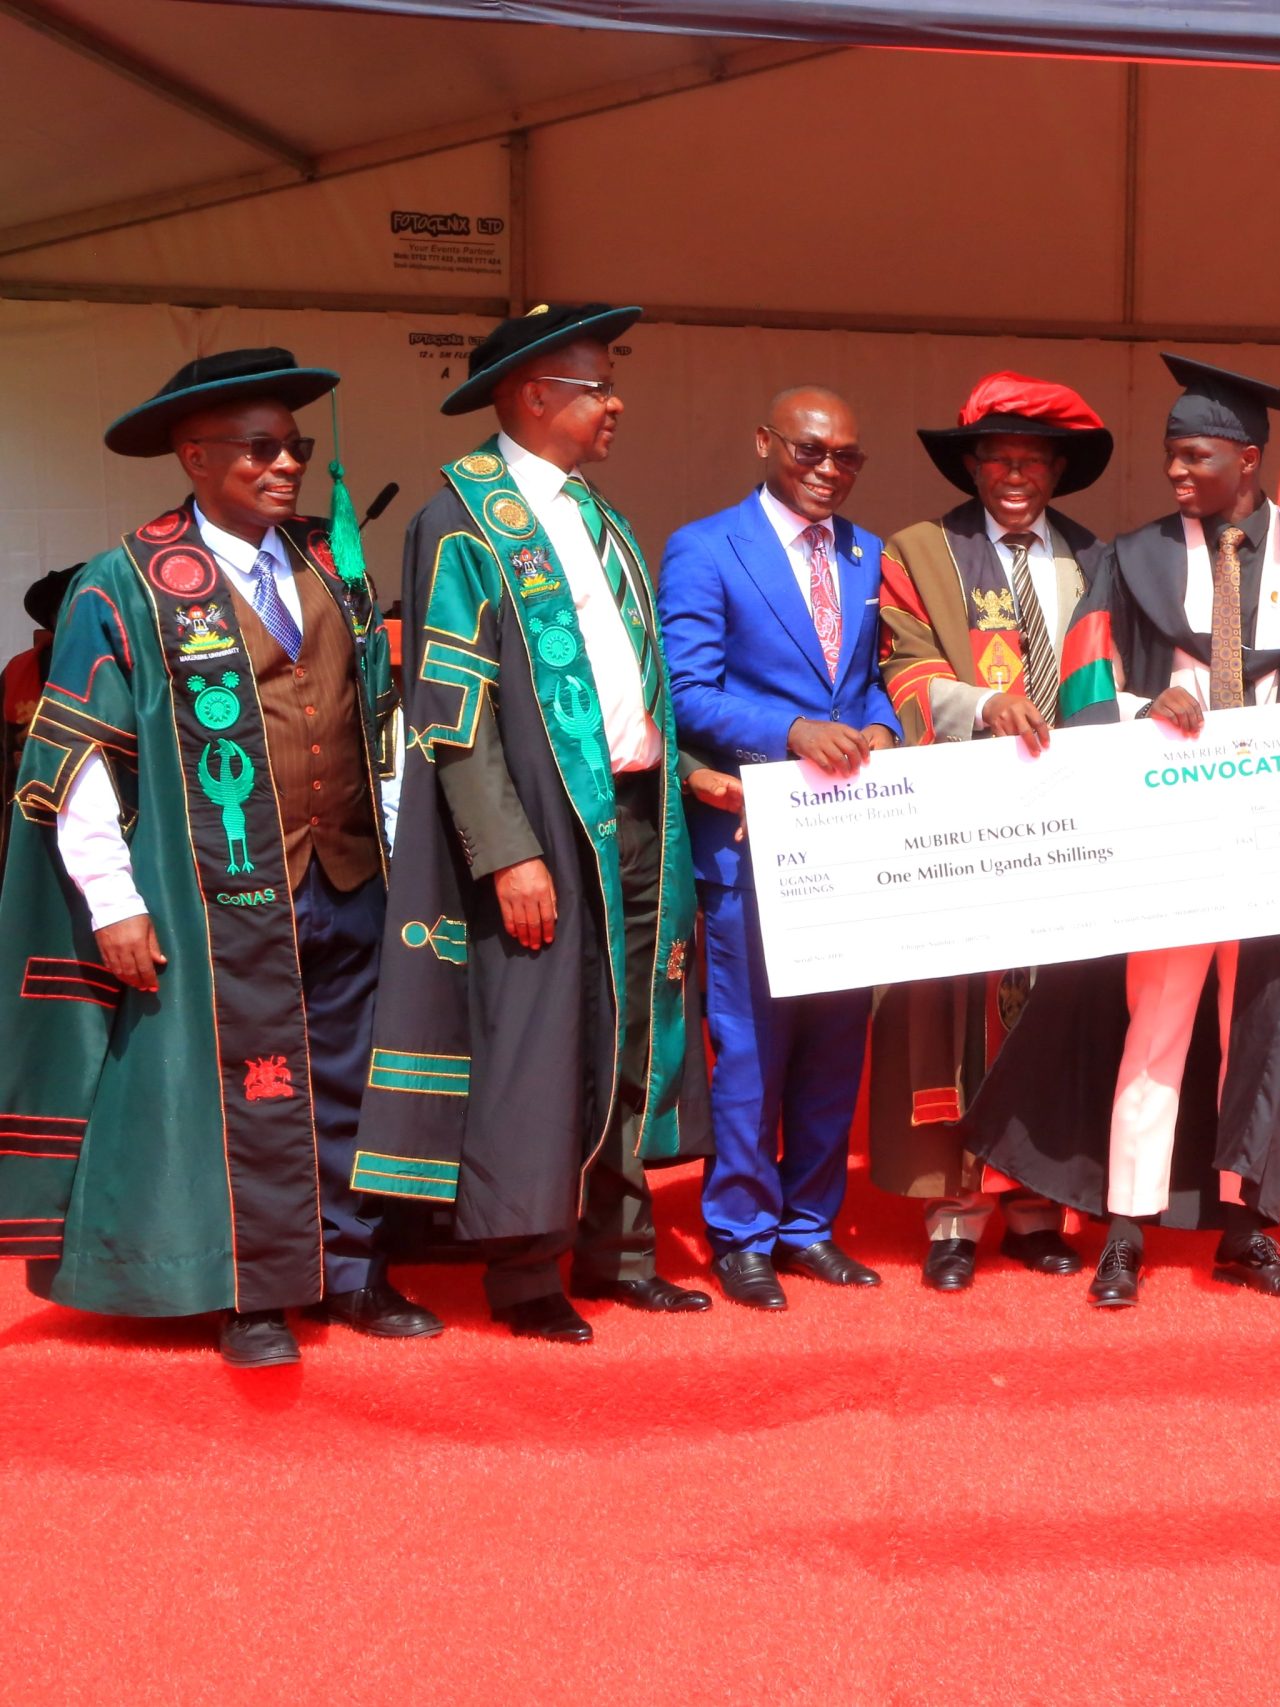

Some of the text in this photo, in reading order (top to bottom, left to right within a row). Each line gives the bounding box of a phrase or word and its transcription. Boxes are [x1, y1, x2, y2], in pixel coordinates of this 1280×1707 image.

[391, 211, 504, 237] FOTOGENIX LTD
[409, 243, 495, 255] Your Events Partner
[409, 333, 464, 346] FOTOGENIX
[613, 346, 632, 356] LTD
[441, 367, 450, 379] A
[795, 802, 918, 829] Makerere Branch
[904, 817, 1078, 850] MUBIRU ENOCK JOEL
[776, 851, 807, 867] PAY
[877, 845, 1114, 885] One Million Uganda Shillings
[779, 872, 830, 887] UGANDA
[217, 888, 275, 906] CoNAS
[780, 883, 835, 898] SHILLINGS
